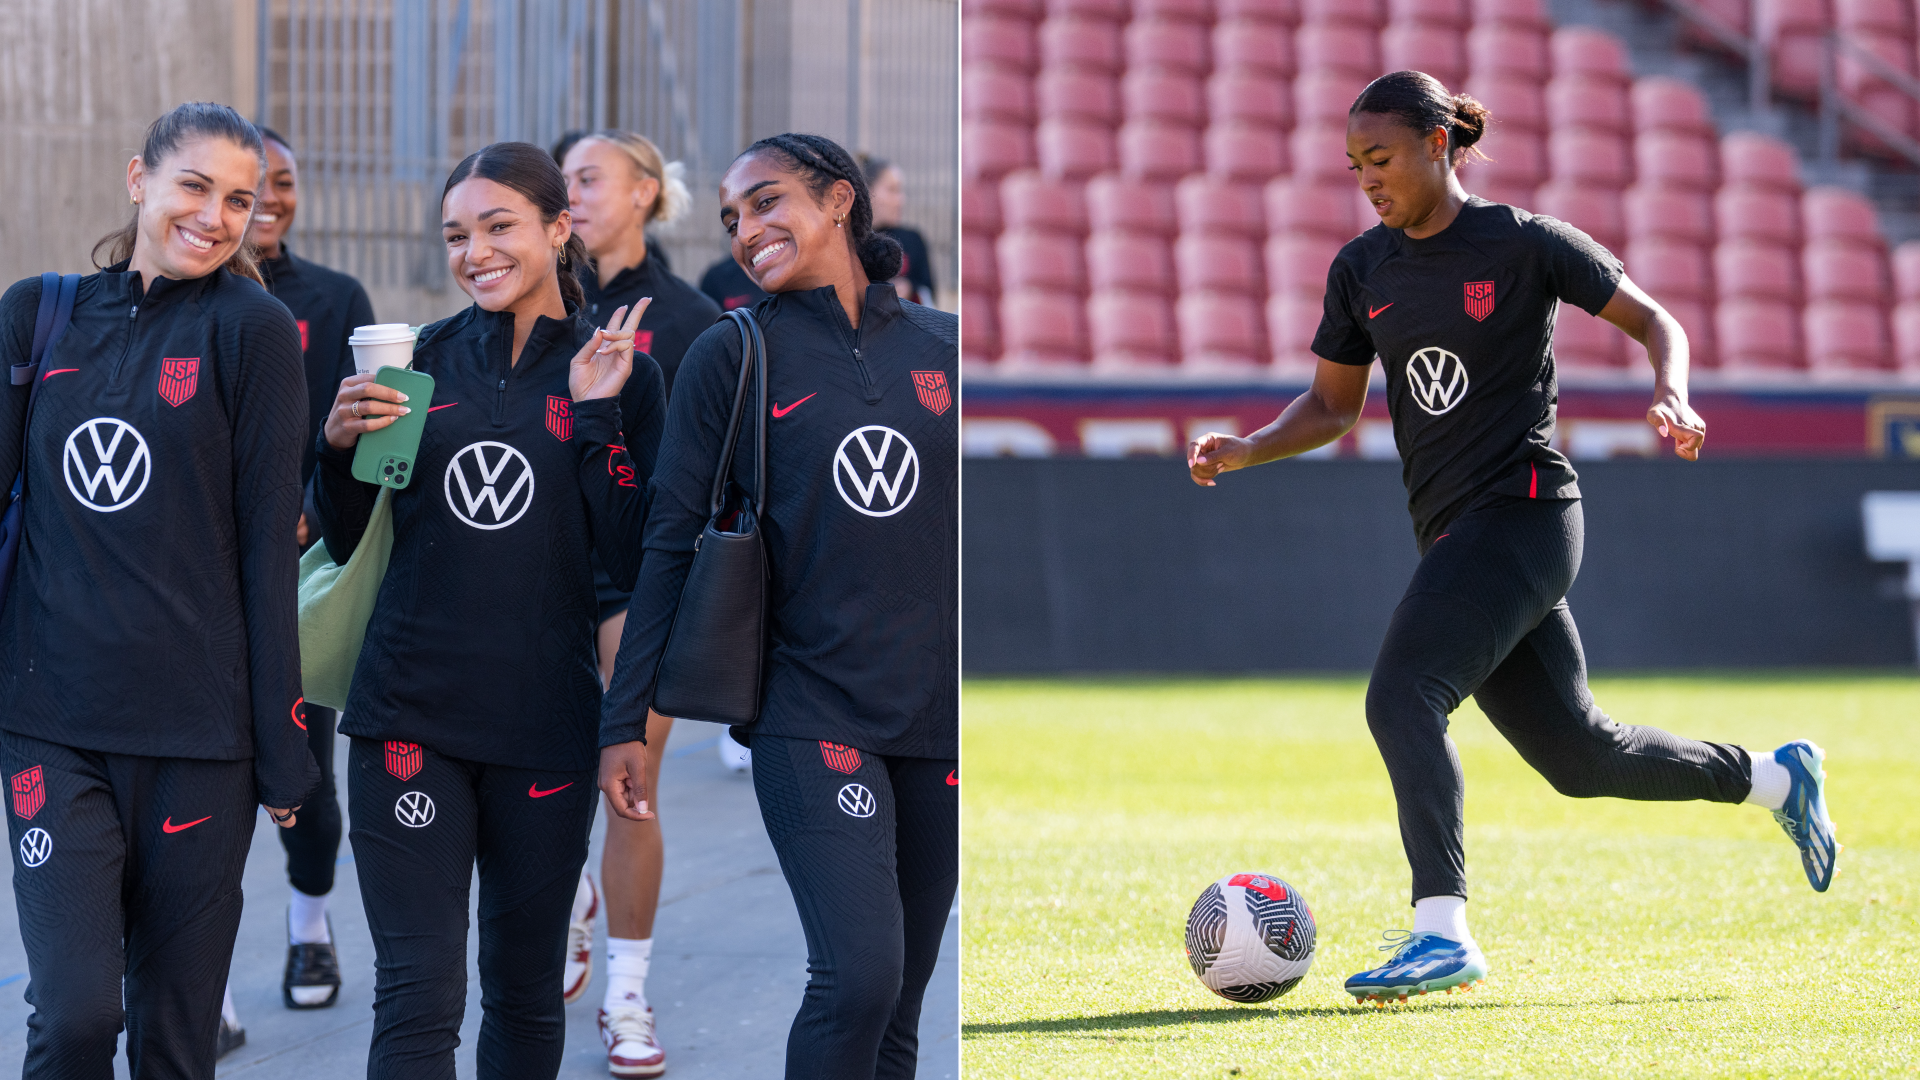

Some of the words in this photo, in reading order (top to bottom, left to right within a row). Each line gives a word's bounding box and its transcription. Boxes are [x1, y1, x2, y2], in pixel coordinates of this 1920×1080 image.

[1467, 284, 1492, 299] USA
[165, 361, 197, 380] USA
[914, 373, 945, 390] USA
[1408, 349, 1465, 411] VW
[550, 398, 573, 417] US
[66, 420, 149, 506] VW
[835, 428, 917, 510] VW
[447, 443, 532, 524] VW
[13, 769, 41, 793] USA
[395, 792, 434, 826] VW
[838, 785, 873, 815] VW
[21, 829, 50, 864] VW
